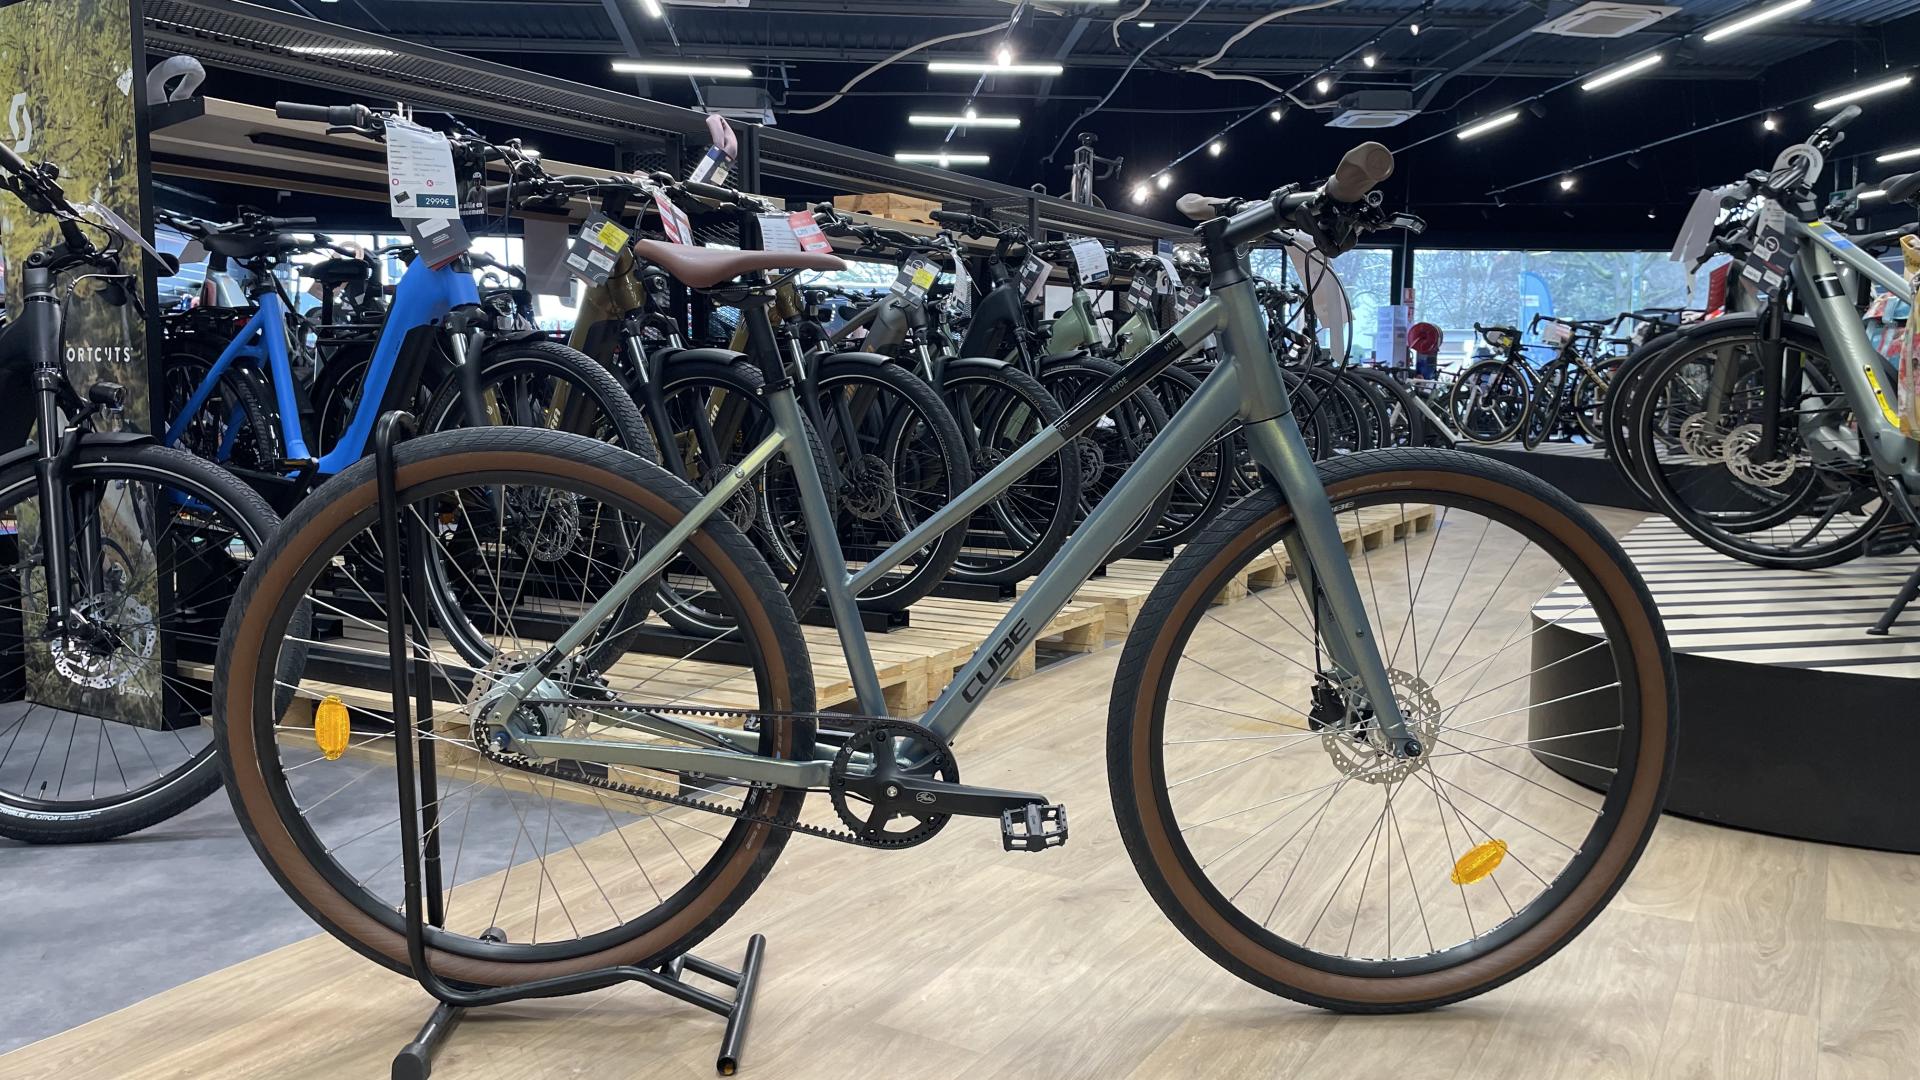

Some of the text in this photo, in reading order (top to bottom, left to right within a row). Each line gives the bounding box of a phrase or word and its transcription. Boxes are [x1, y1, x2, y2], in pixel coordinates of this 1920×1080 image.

[425, 197, 450, 206] 2999€
[1163, 337, 1179, 351] HYD
[66, 346, 131, 363] ORTCUTS
[1109, 377, 1129, 393] HYDE
[962, 617, 1031, 703] CUBE
